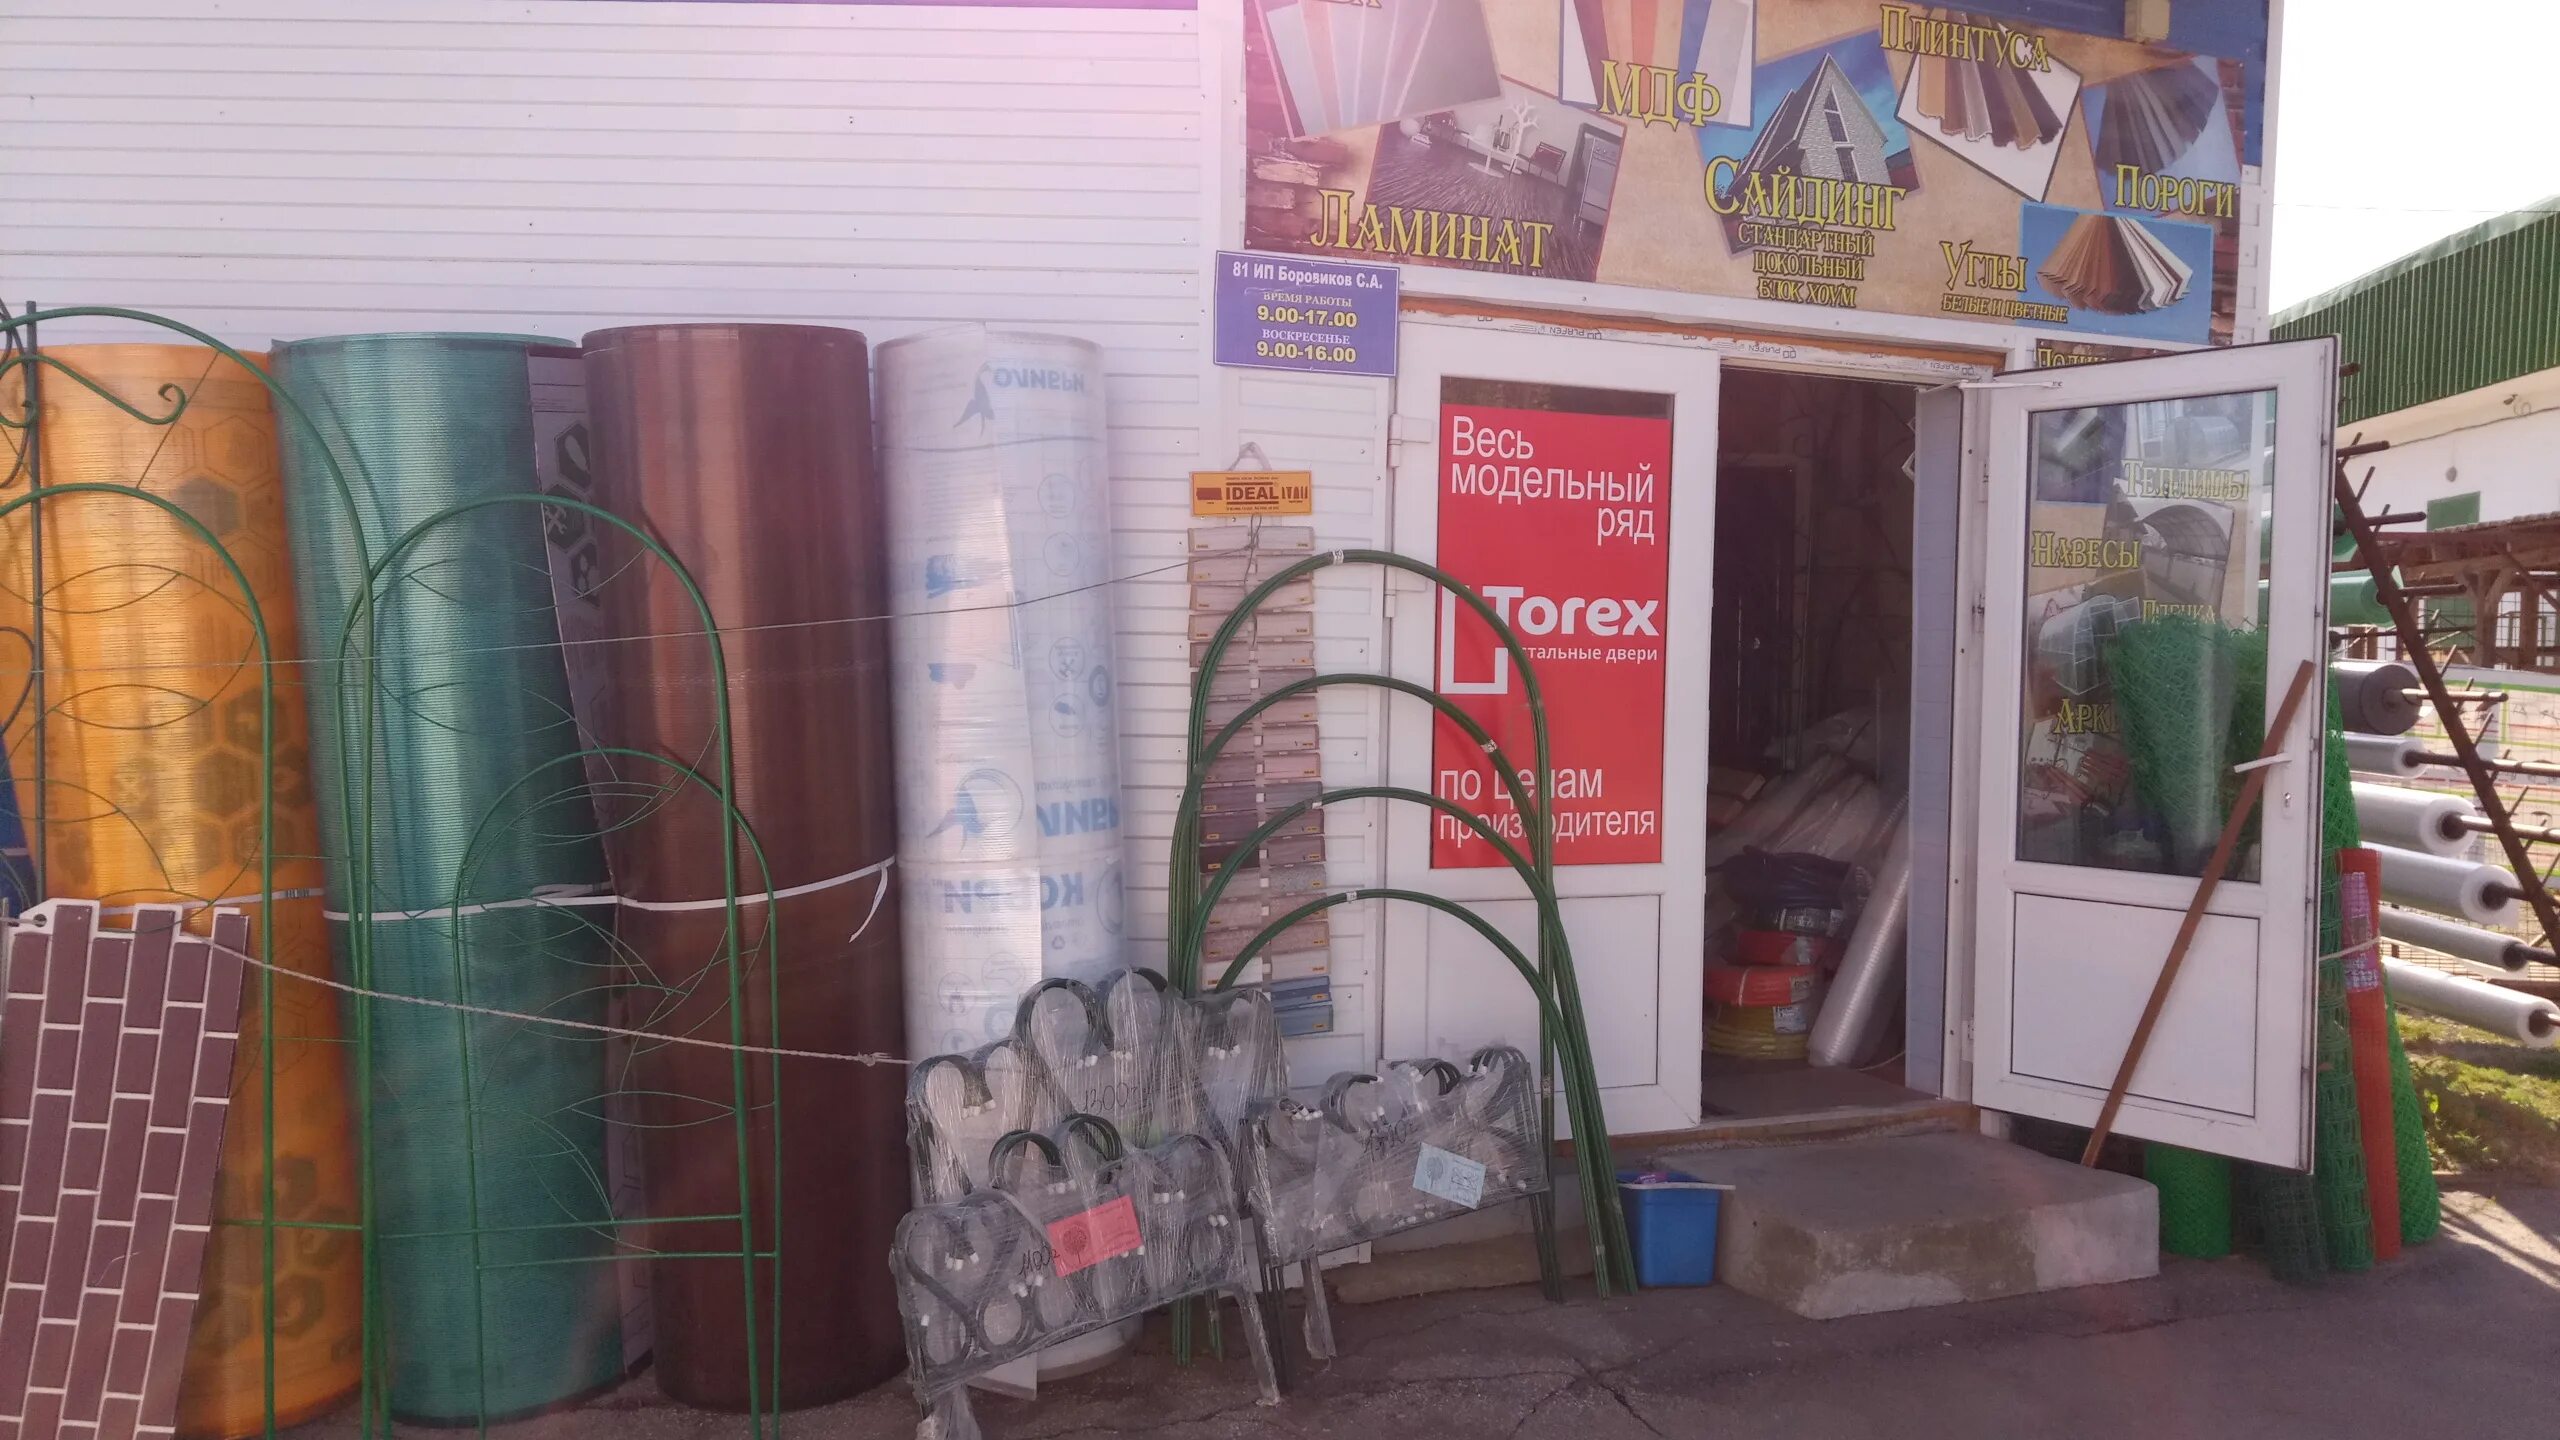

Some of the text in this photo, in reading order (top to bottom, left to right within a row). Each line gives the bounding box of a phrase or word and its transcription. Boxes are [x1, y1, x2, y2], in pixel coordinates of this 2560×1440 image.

[1880, 4, 2050, 73] ПЛИНТУСА
[1600, 60, 1721, 131] МДФ
[1704, 156, 1906, 231] САЙДИНГ
[2114, 163, 2236, 219] ПОРОГИ
[1310, 188, 1553, 269] ЛАМИНАТ
[1738, 221, 1875, 257] СТАНДАРТНЫЙ
[1232, 261, 1383, 289] 81 ИП Боровиков С.А.
[1753, 249, 1864, 280] ЦОКОЛЬНЫЙ
[1939, 240, 2028, 292] УГЛЫ
[1263, 291, 1353, 308] ВРЕМЯ РАБОТЫ
[1757, 276, 1857, 308] БЛОК ХОУМ
[1941, 293, 2070, 324] БЕЛЫЕ И ЦВЕТНЫЕ
[1256, 304, 1358, 328] 9.00-17.00
[1256, 340, 1357, 364] 9.00-16.00
[1262, 328, 1351, 345] ВОСКРЕСЕНЬЕ
[1451, 415, 1534, 460] Весь
[1225, 486, 1279, 500] IDEAL
[1451, 462, 1655, 505] модельный
[1597, 507, 1655, 547] ряд
[2031, 531, 2142, 569] НАВЕСЫ
[1482, 586, 1660, 637] Torex
[1605, 647, 1658, 664] двери
[1440, 769, 1482, 802] по
